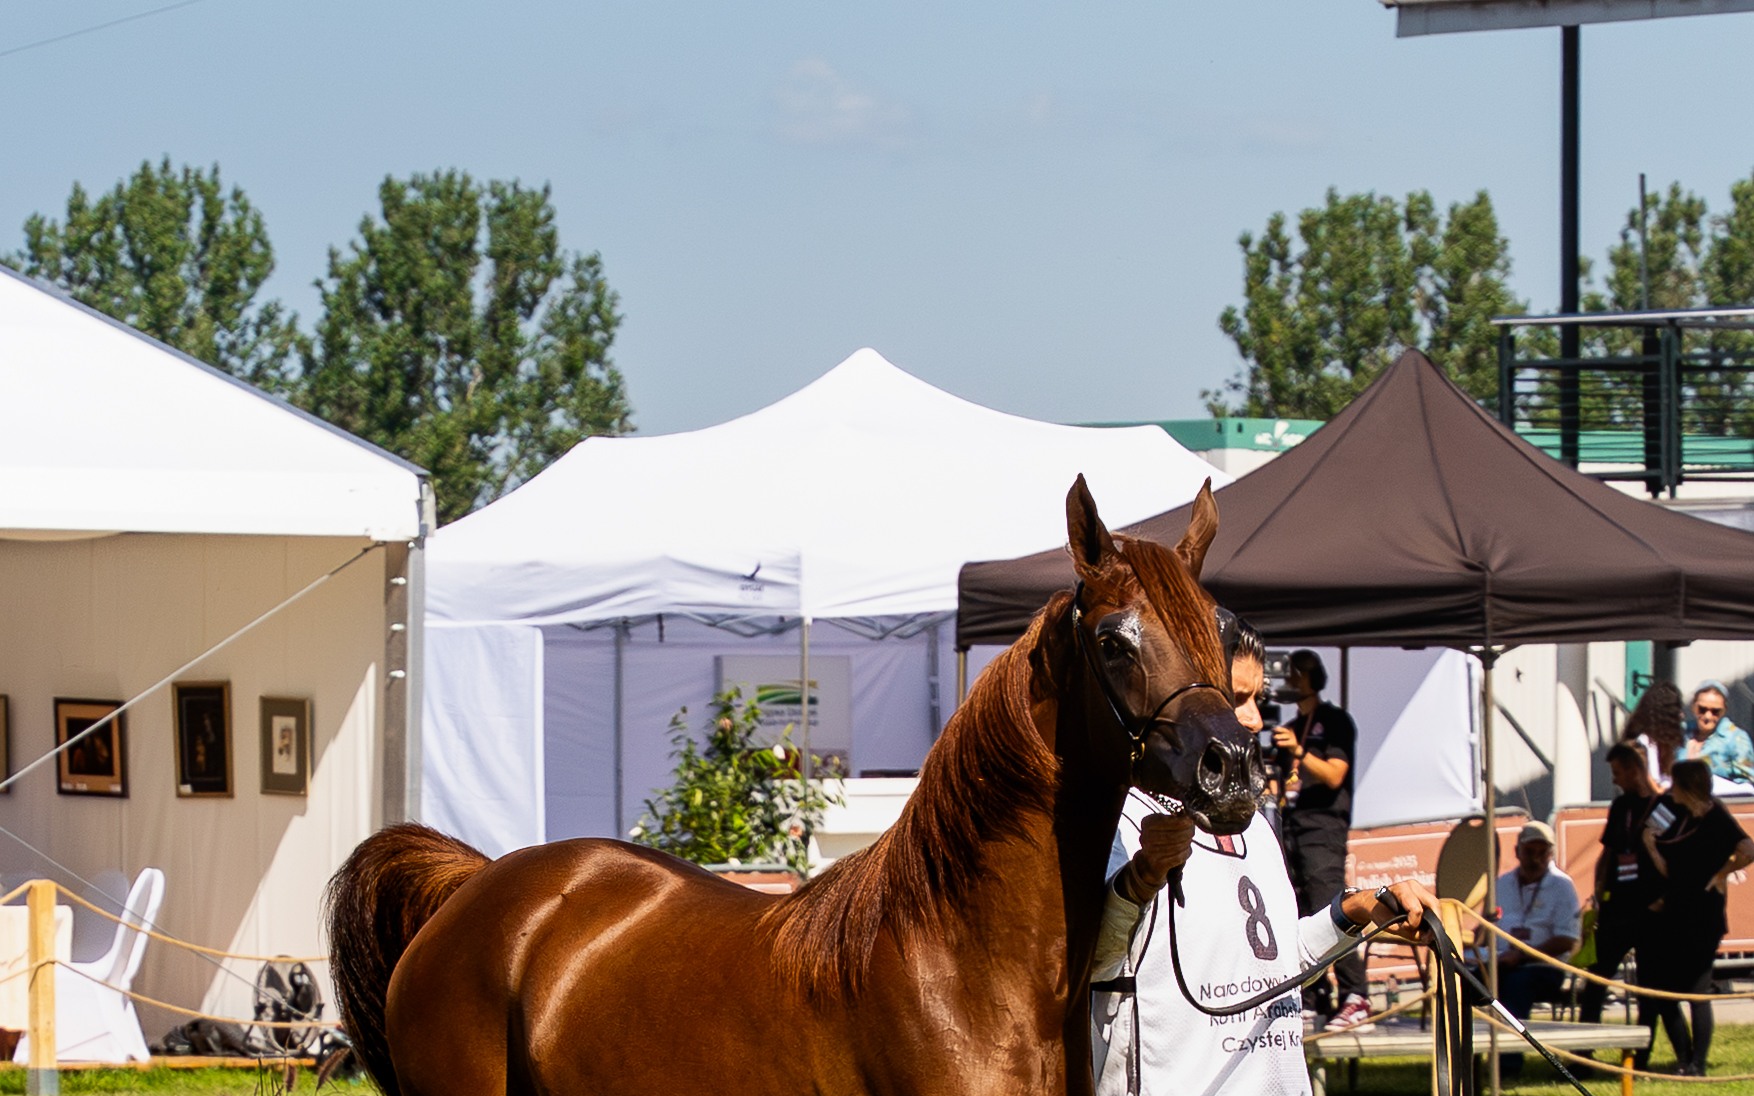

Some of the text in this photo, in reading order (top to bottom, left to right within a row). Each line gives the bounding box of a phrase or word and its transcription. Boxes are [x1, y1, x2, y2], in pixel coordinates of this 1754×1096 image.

[1238, 876, 1278, 960] 8
[1222, 1030, 1303, 1053] Czystej Kr
